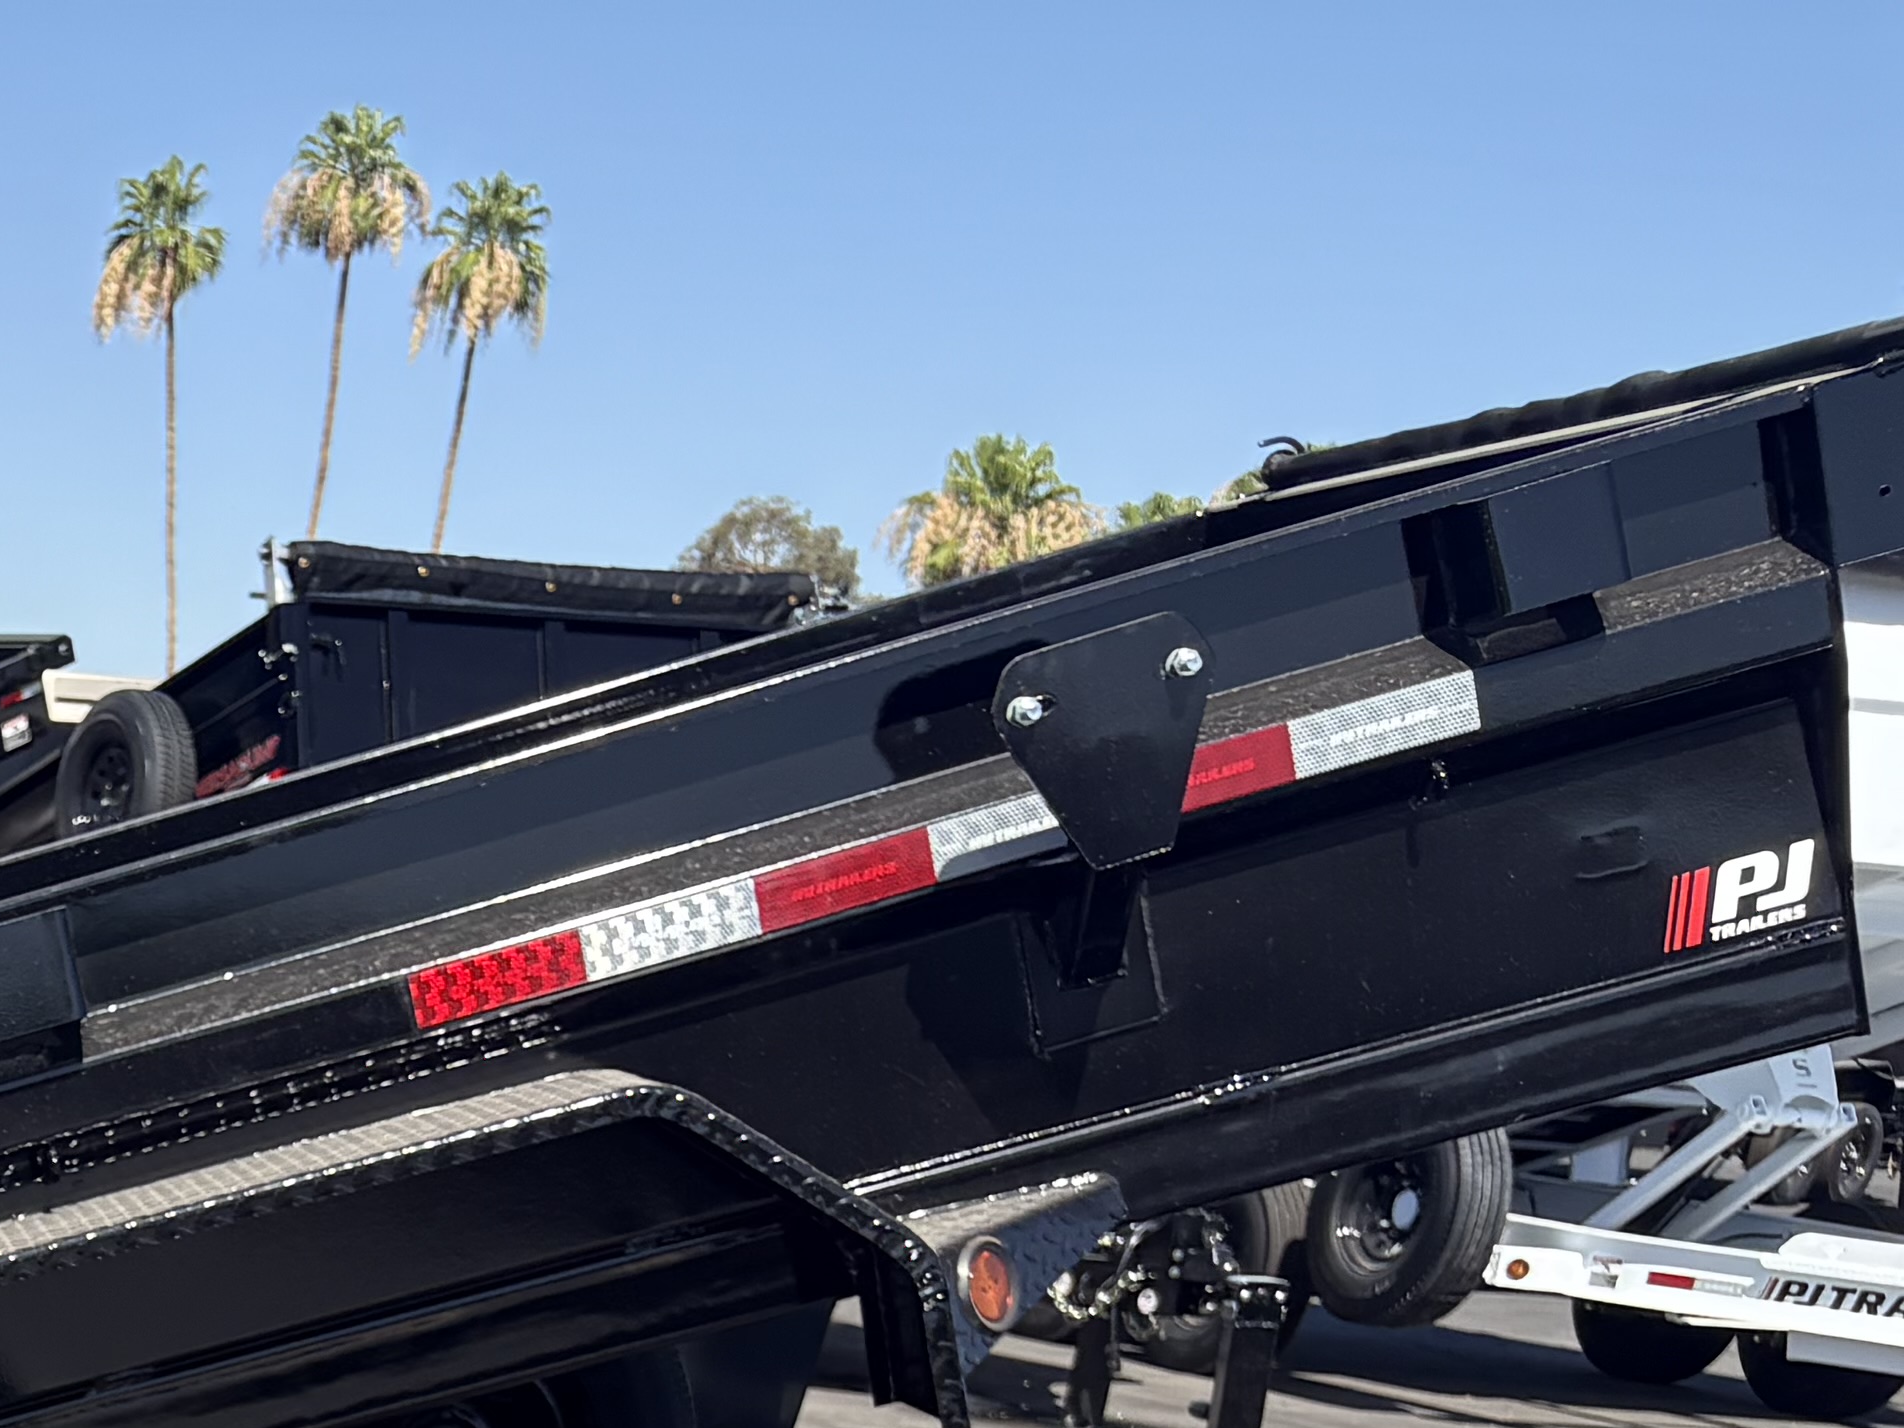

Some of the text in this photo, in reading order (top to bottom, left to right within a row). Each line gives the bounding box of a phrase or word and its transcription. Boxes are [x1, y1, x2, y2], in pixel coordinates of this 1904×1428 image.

[1712, 838, 1815, 924] PJ
[1709, 903, 1807, 942] TRAILERS
[1774, 1279, 1826, 1306] PJ
